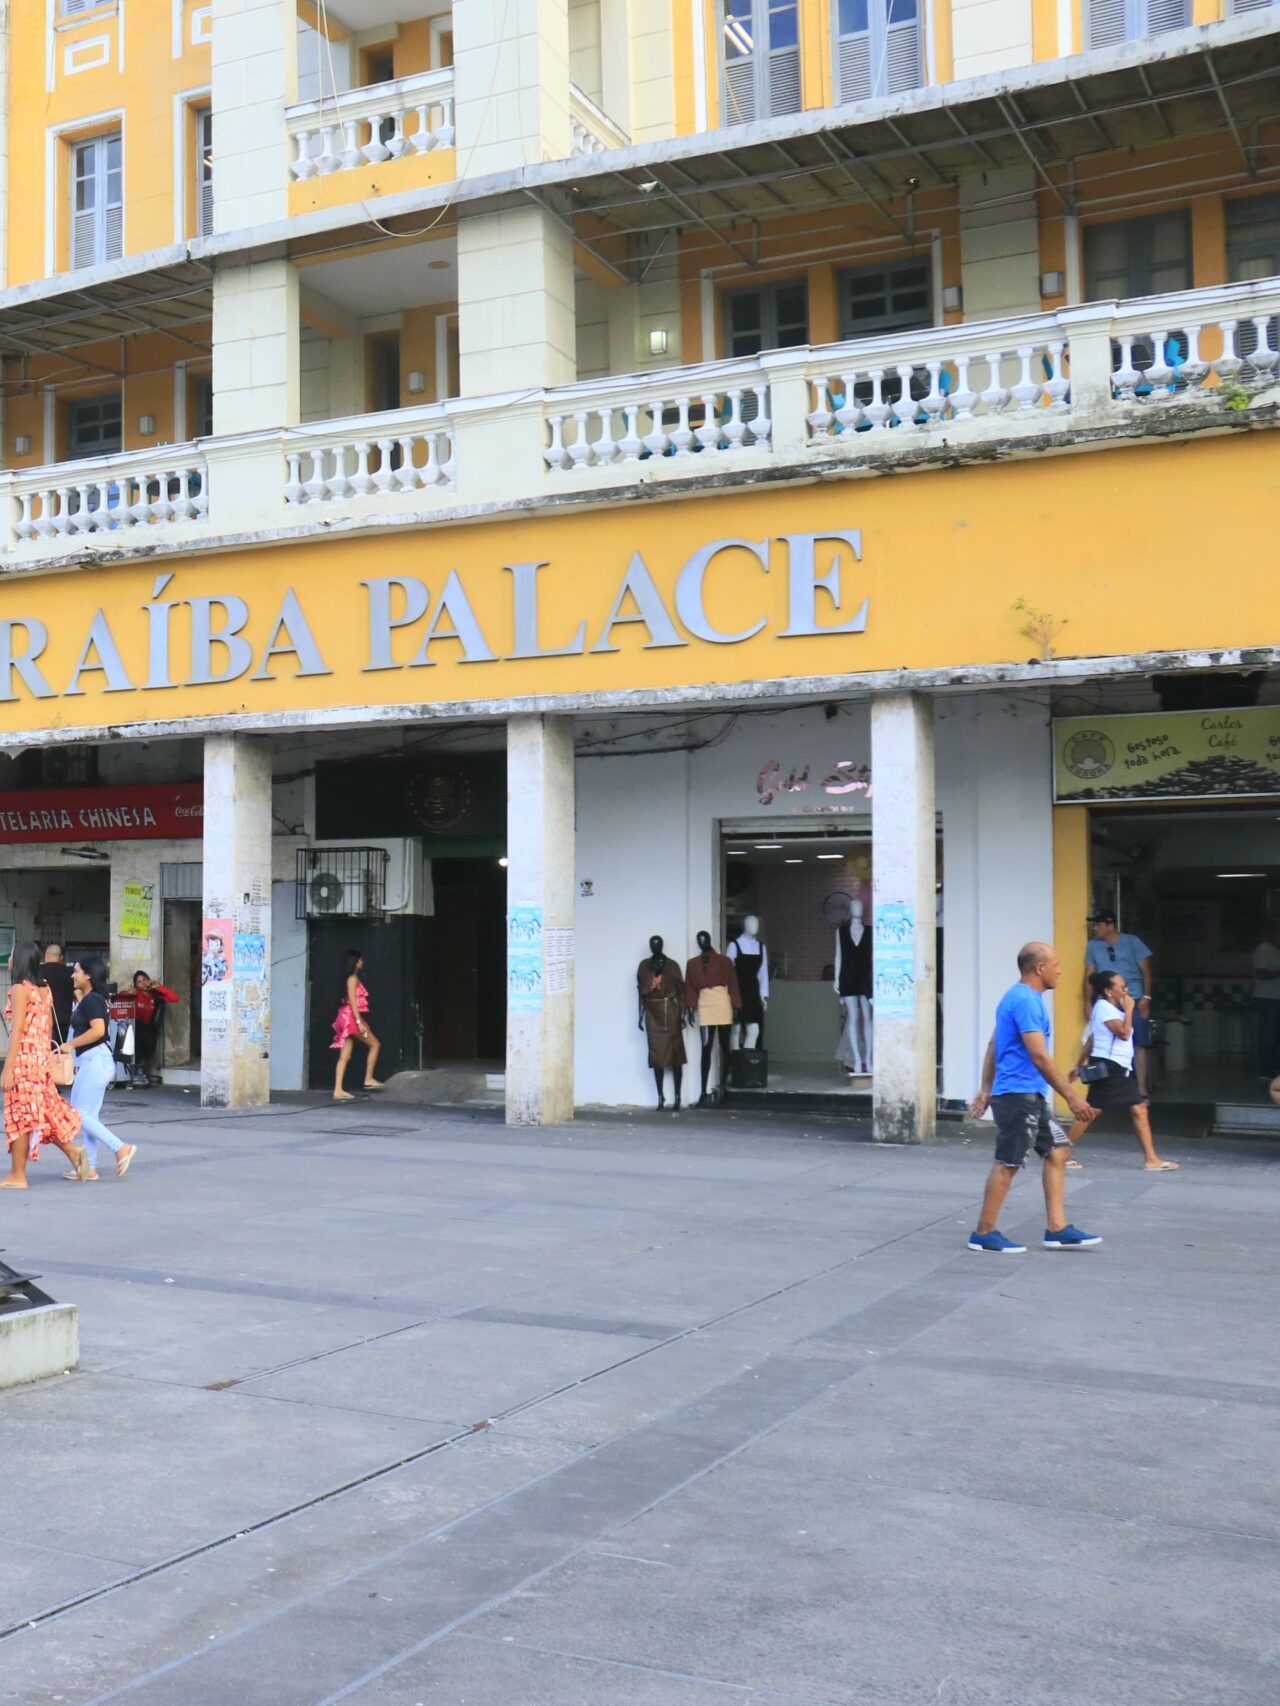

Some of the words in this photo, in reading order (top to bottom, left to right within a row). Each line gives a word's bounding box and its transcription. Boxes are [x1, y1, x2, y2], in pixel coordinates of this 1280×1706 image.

[360, 528, 870, 672] PALACE
[1208, 733, 1238, 750] Café
[1124, 757, 1149, 770] toda
[1154, 746, 1182, 761] hora
[79, 806, 157, 829] CHINESA
